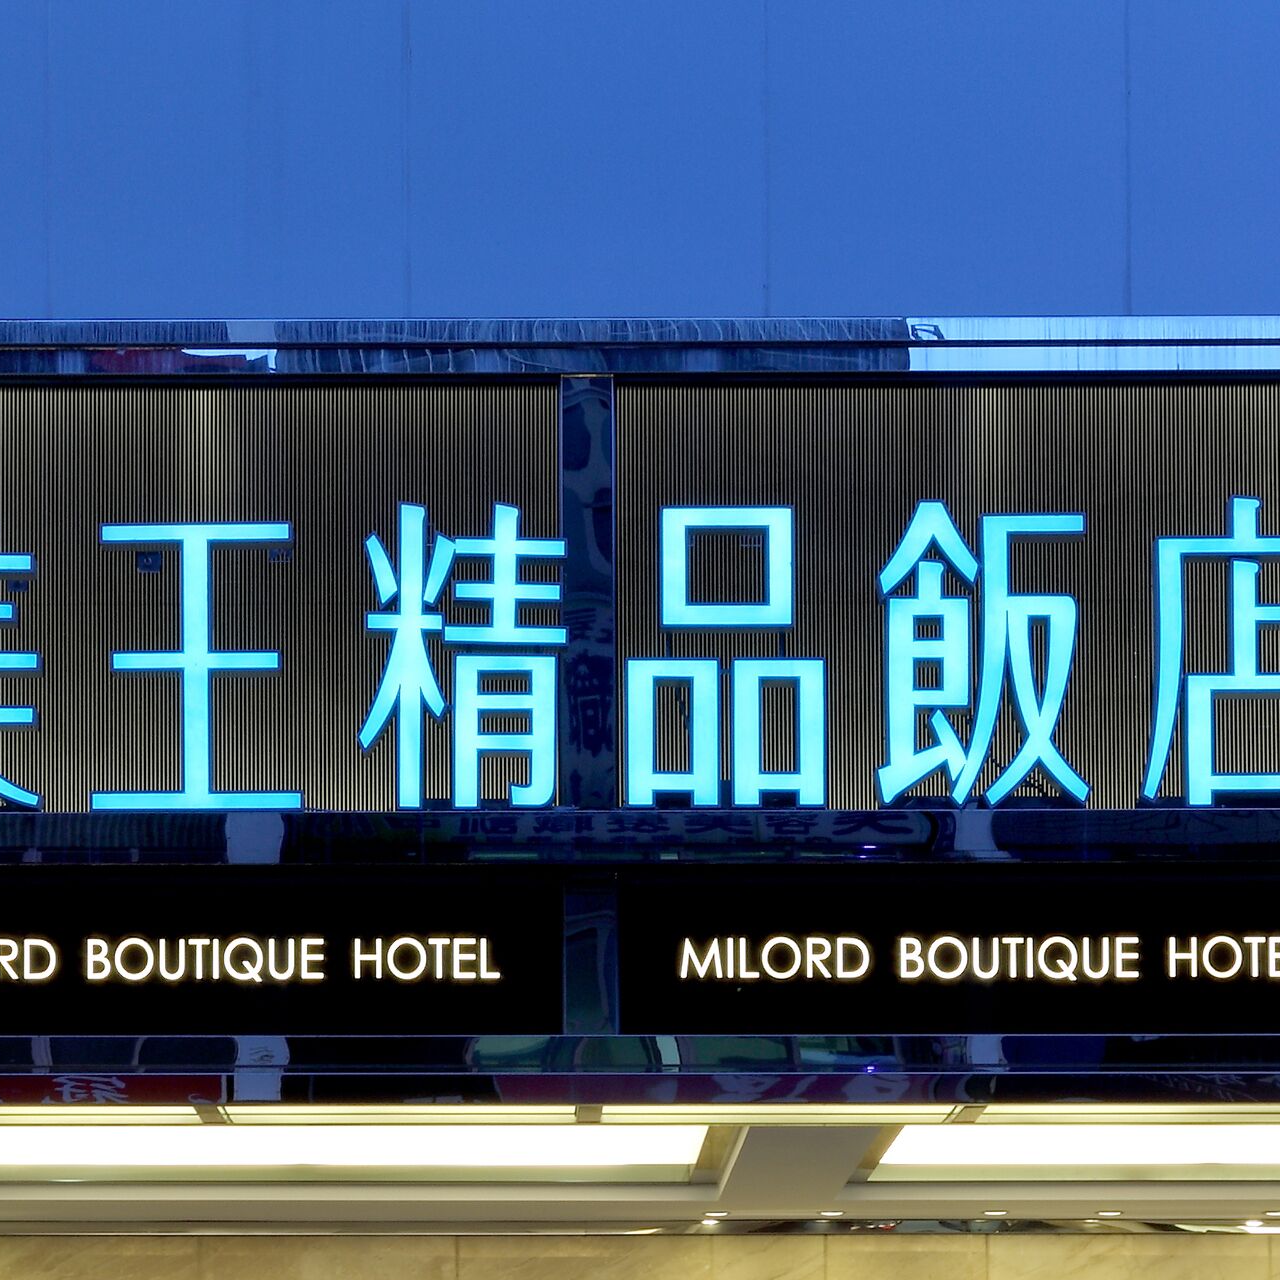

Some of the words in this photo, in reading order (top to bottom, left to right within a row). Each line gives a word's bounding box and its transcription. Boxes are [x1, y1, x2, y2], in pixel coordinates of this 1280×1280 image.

[85, 936, 326, 984] BOUTIQUE
[352, 935, 502, 982] HOTEL
[678, 935, 871, 981] MILORD
[897, 934, 1141, 983] BOUTIQUE
